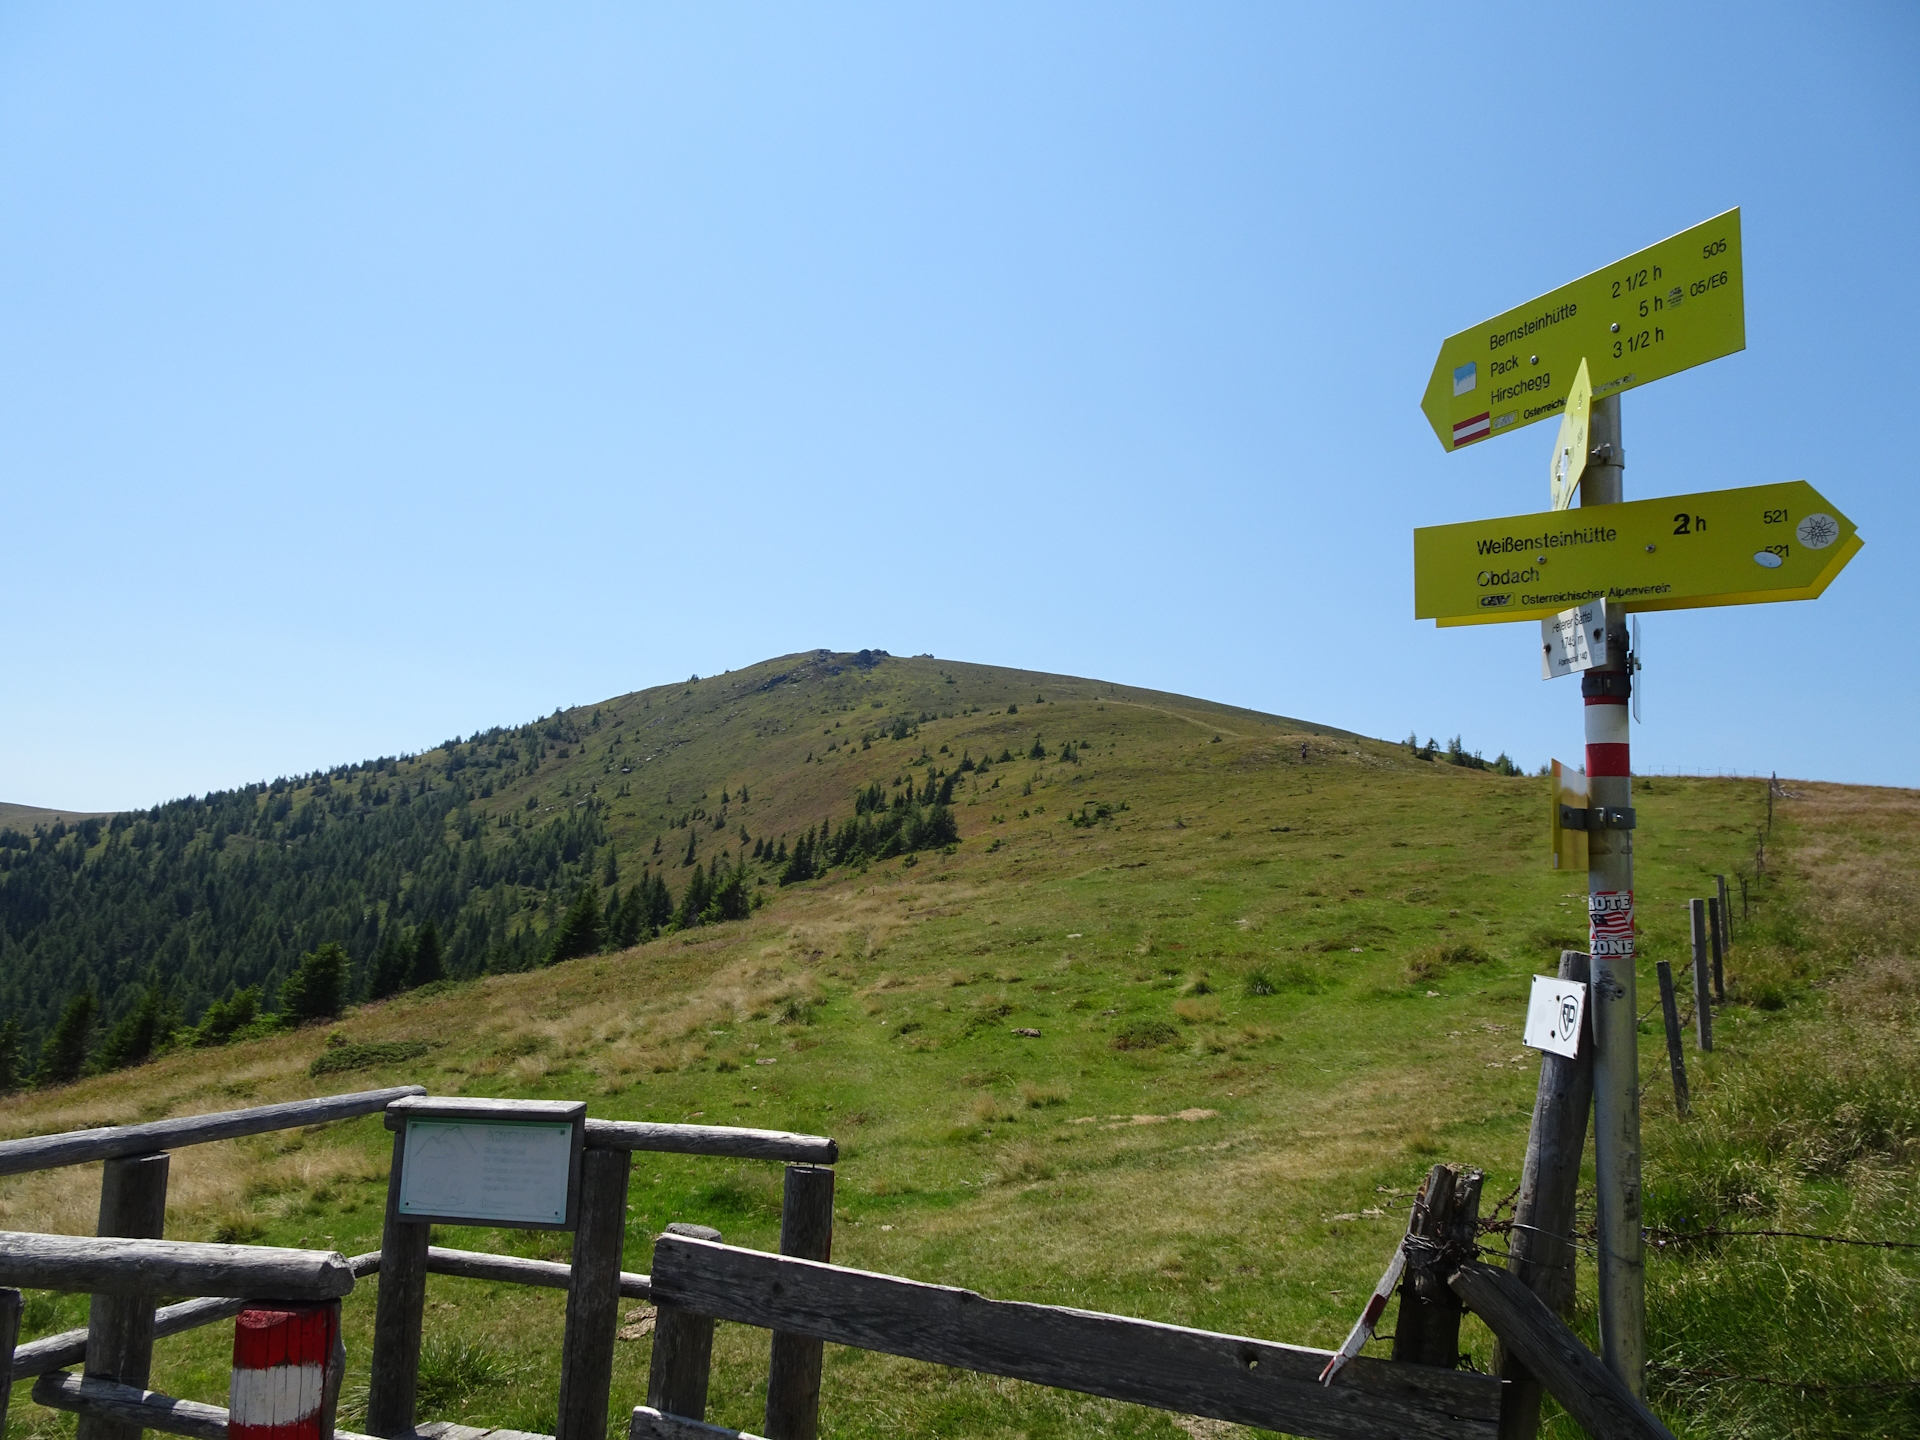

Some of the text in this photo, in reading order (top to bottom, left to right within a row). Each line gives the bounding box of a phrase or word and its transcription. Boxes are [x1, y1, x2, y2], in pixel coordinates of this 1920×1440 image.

[1703, 238, 1727, 259] 505
[1690, 271, 1728, 297] 05/E6
[1490, 265, 1662, 350] Bernsteinhütte 2 1/2 h
[1490, 355, 1519, 377] Pack
[1639, 299, 1649, 317] 5
[1654, 296, 1663, 311] h
[1490, 326, 1664, 405] Hirschegg 3 1/2 h
[1763, 509, 1788, 524] 521
[1477, 526, 1617, 555] Weißensteinhütte
[1695, 516, 1707, 532] h
[1477, 567, 1540, 587] Obdach
[1522, 588, 1605, 605] Österreichischer
[1609, 583, 1671, 598] Alpenverein
[1574, 609, 1593, 626] Sattel
[1590, 938, 1634, 956] ZONE
